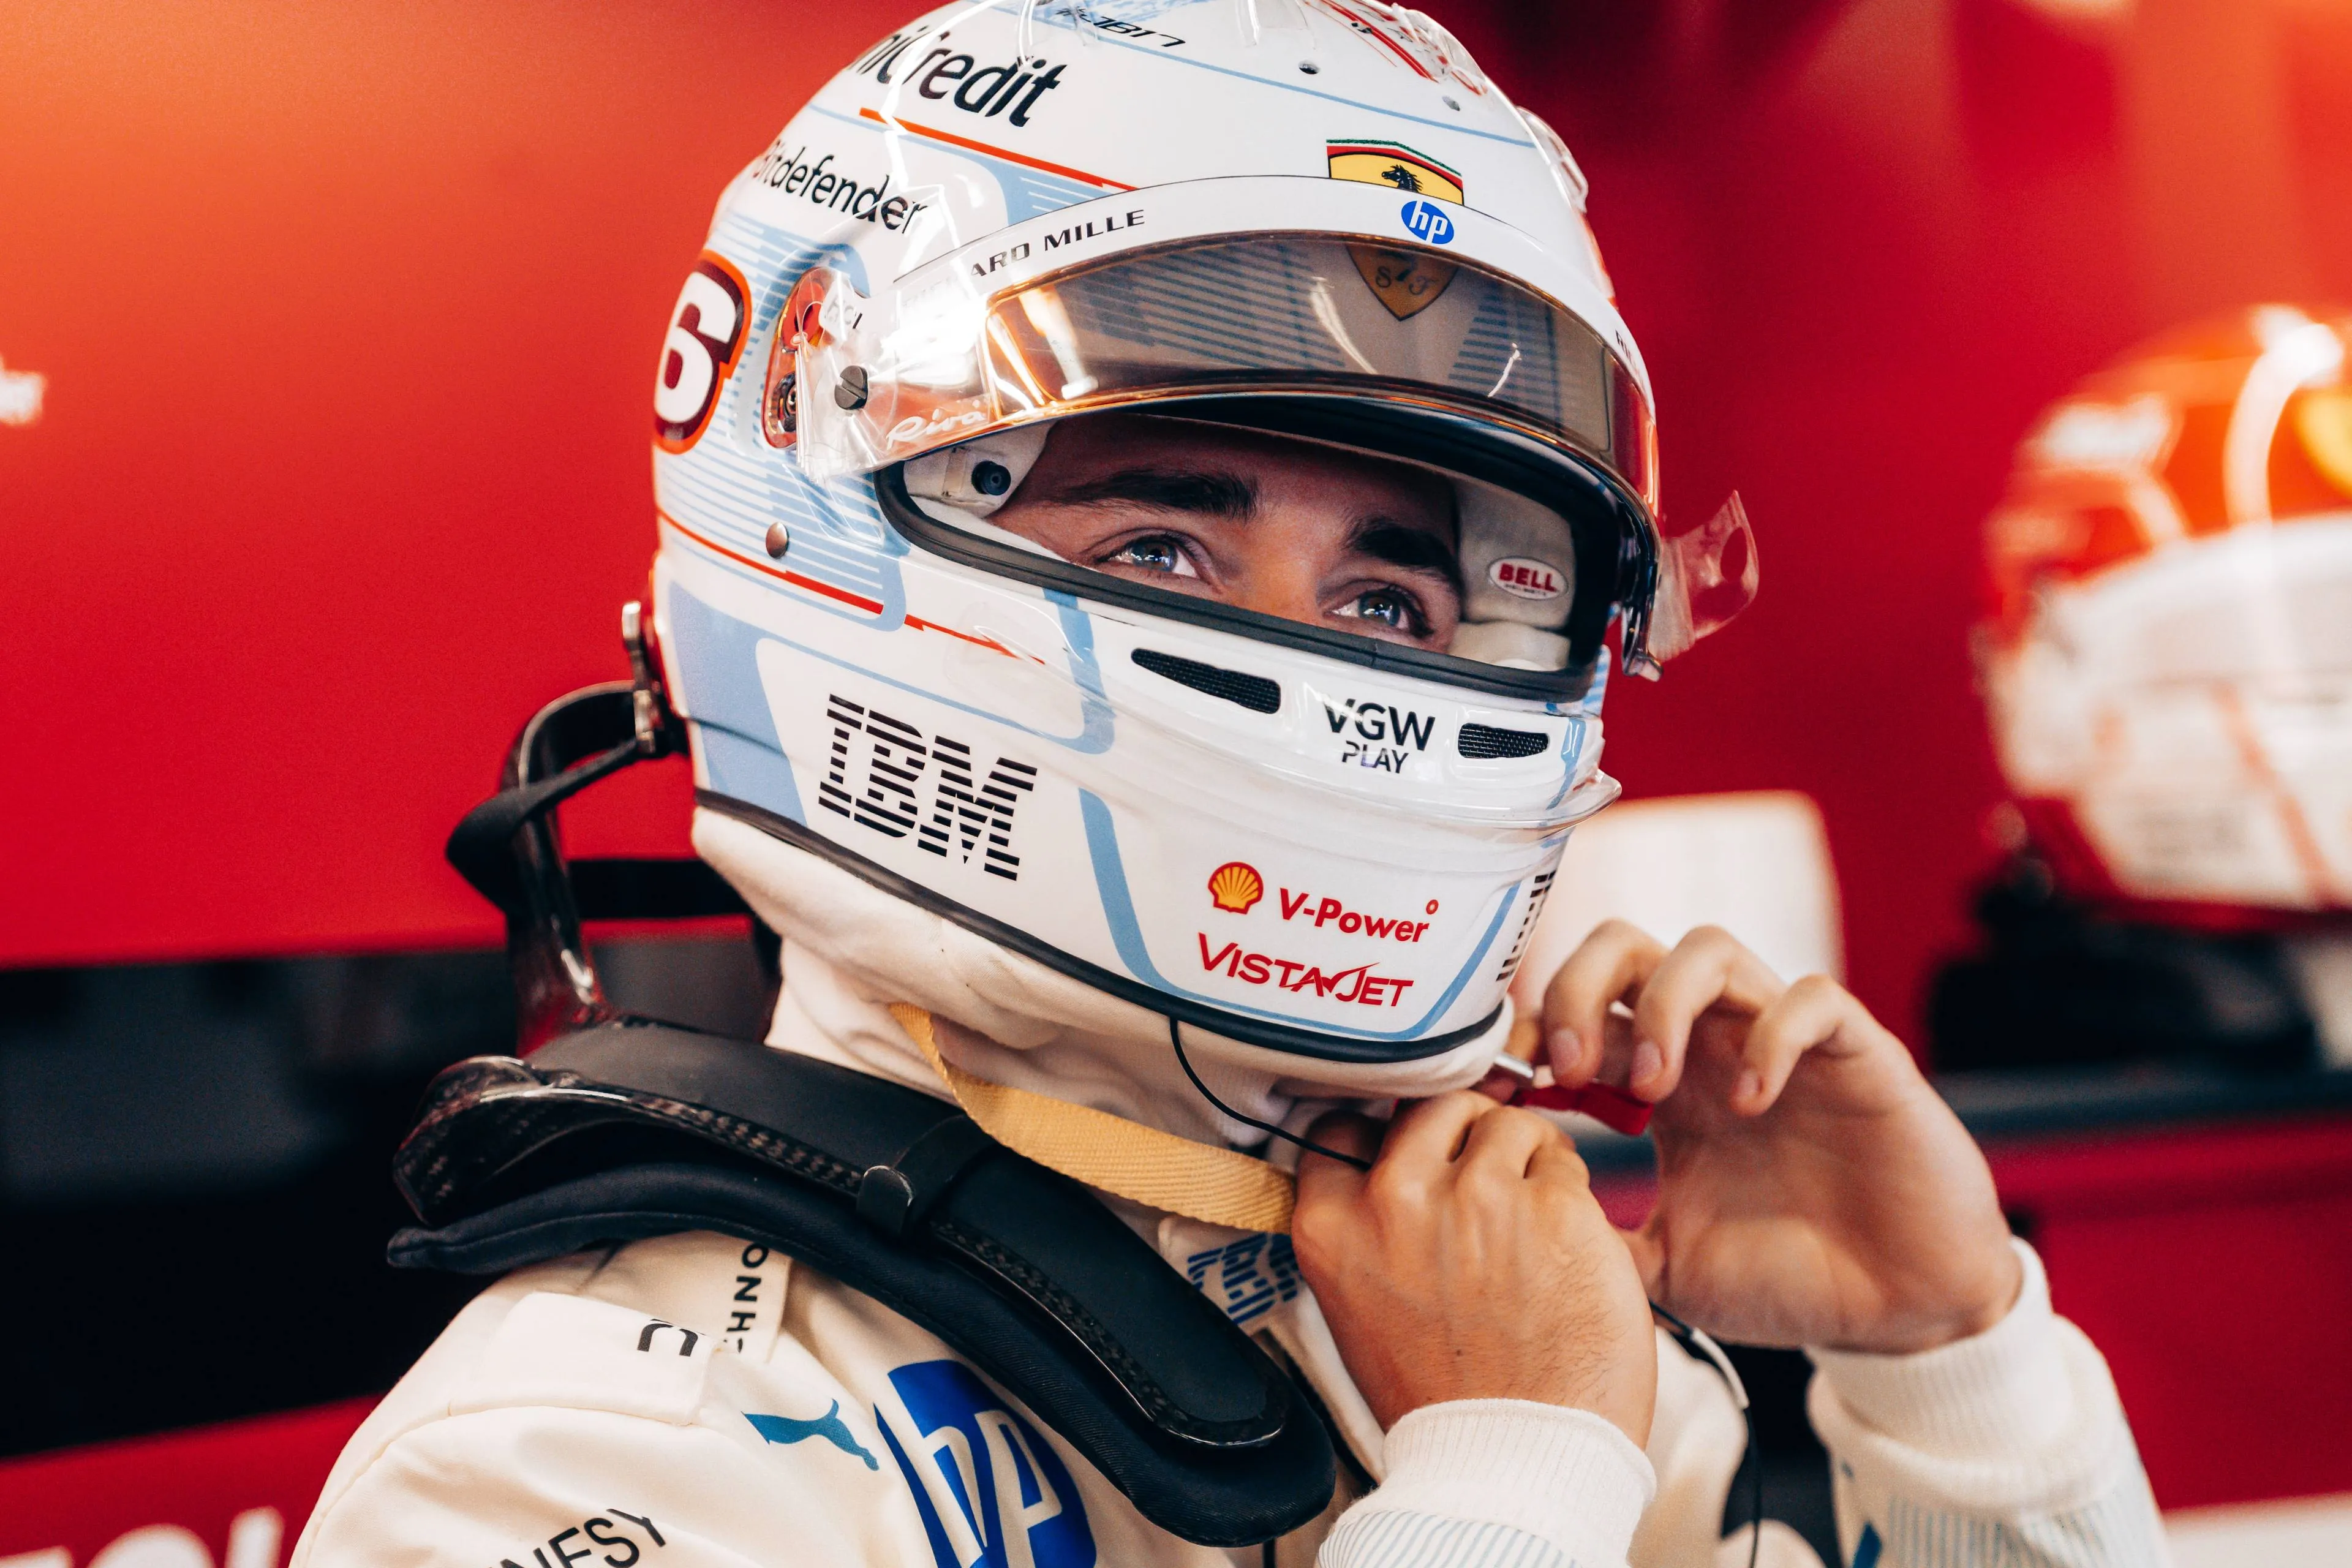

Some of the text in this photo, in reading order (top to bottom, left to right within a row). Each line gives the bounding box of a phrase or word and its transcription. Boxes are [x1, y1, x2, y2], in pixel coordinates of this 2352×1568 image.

[753, 140, 928, 233] itdefender
[1044, 209, 1146, 251] MILLE
[1409, 199, 1449, 244] hp
[654, 271, 737, 424] 6
[886, 402, 988, 450] Riva
[1499, 562, 1558, 592] BELL
[1323, 698, 1436, 751] VGW
[1341, 740, 1409, 774] PLAY
[818, 693, 1038, 881] IBM
[1280, 887, 1430, 943] V-Power
